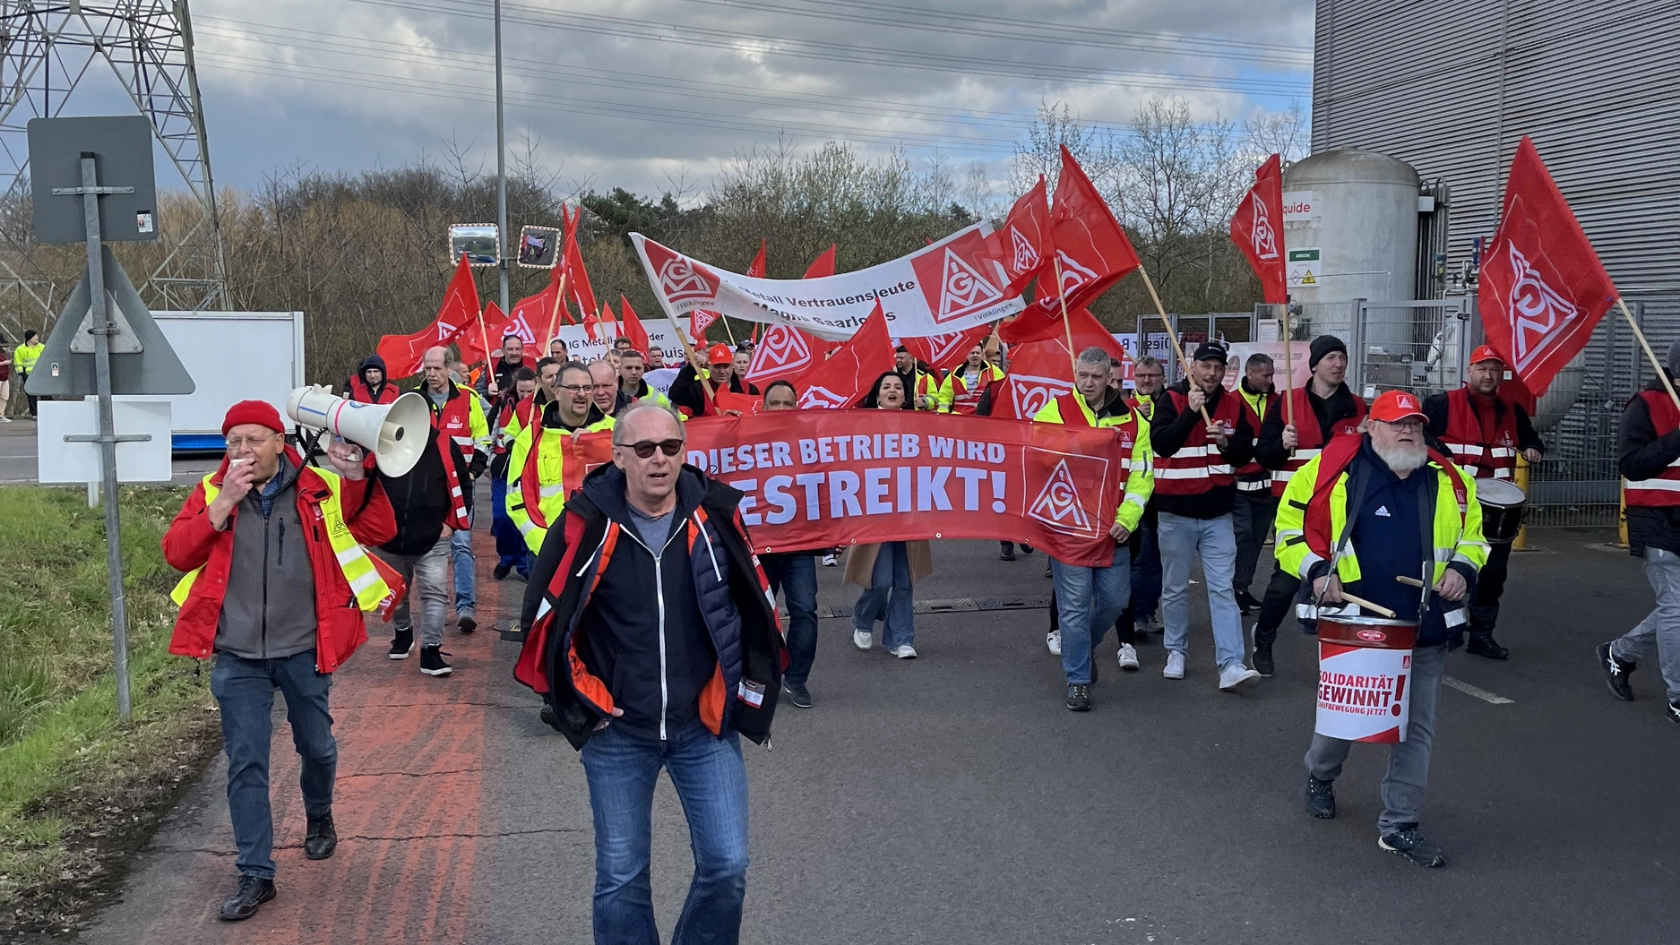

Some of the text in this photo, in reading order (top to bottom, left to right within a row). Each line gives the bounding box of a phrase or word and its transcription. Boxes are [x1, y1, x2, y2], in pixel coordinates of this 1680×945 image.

[785, 280, 915, 307] Vertrauensleute
[813, 311, 896, 328] Saarlos
[569, 340, 579, 349] IG
[687, 434, 1006, 474] DIESER BETRIEB WIRD
[729, 466, 1007, 526] ESTREIKT!
[1318, 701, 1365, 714] FBEWEGUNG
